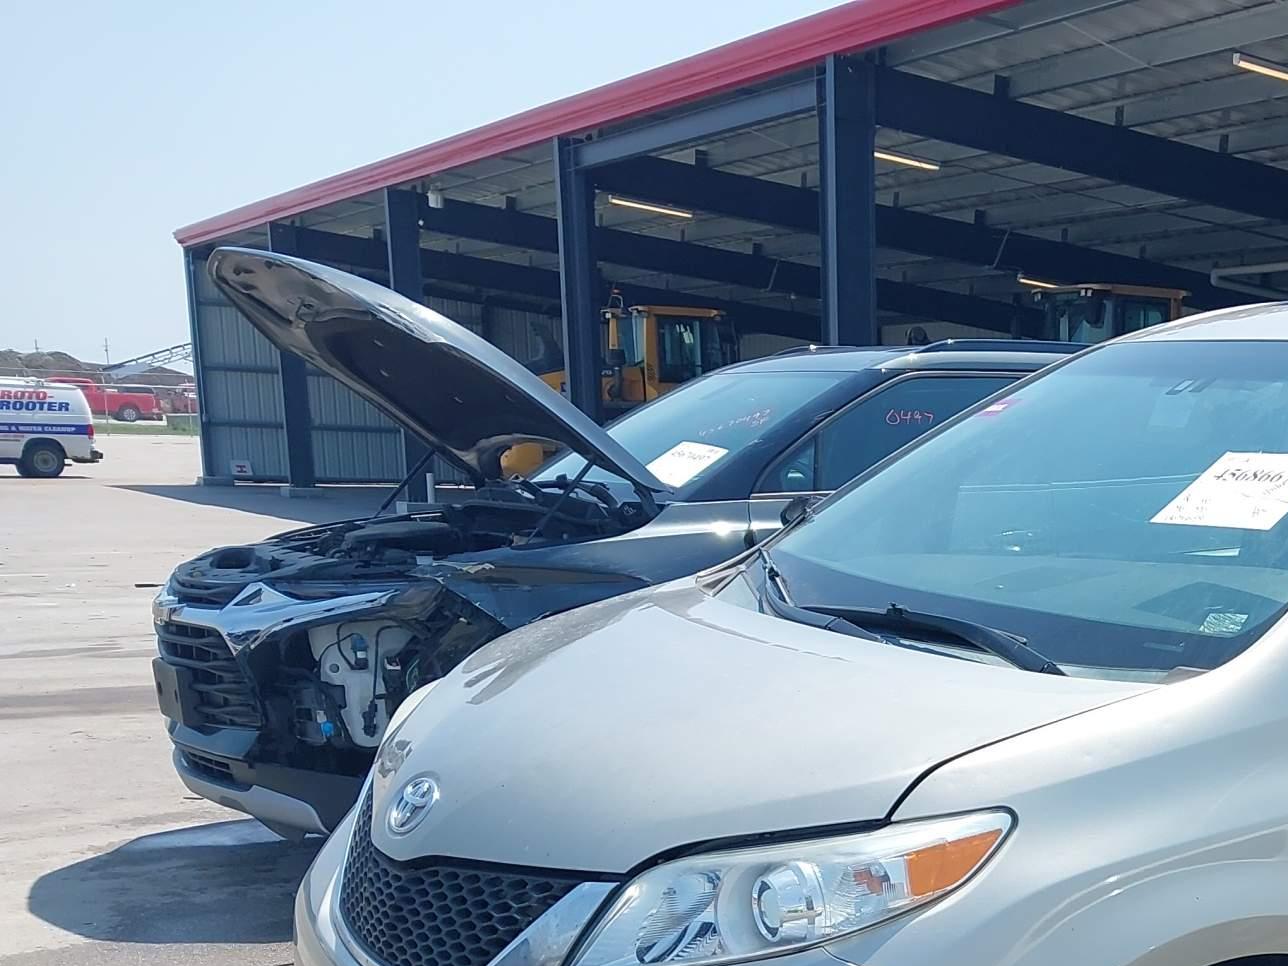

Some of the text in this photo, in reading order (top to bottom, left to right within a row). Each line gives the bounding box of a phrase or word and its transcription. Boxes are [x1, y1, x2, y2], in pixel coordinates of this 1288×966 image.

[0, 390, 54, 400] ROTO-
[0, 400, 70, 411] ROOTER
[886, 409, 934, 425] 0497
